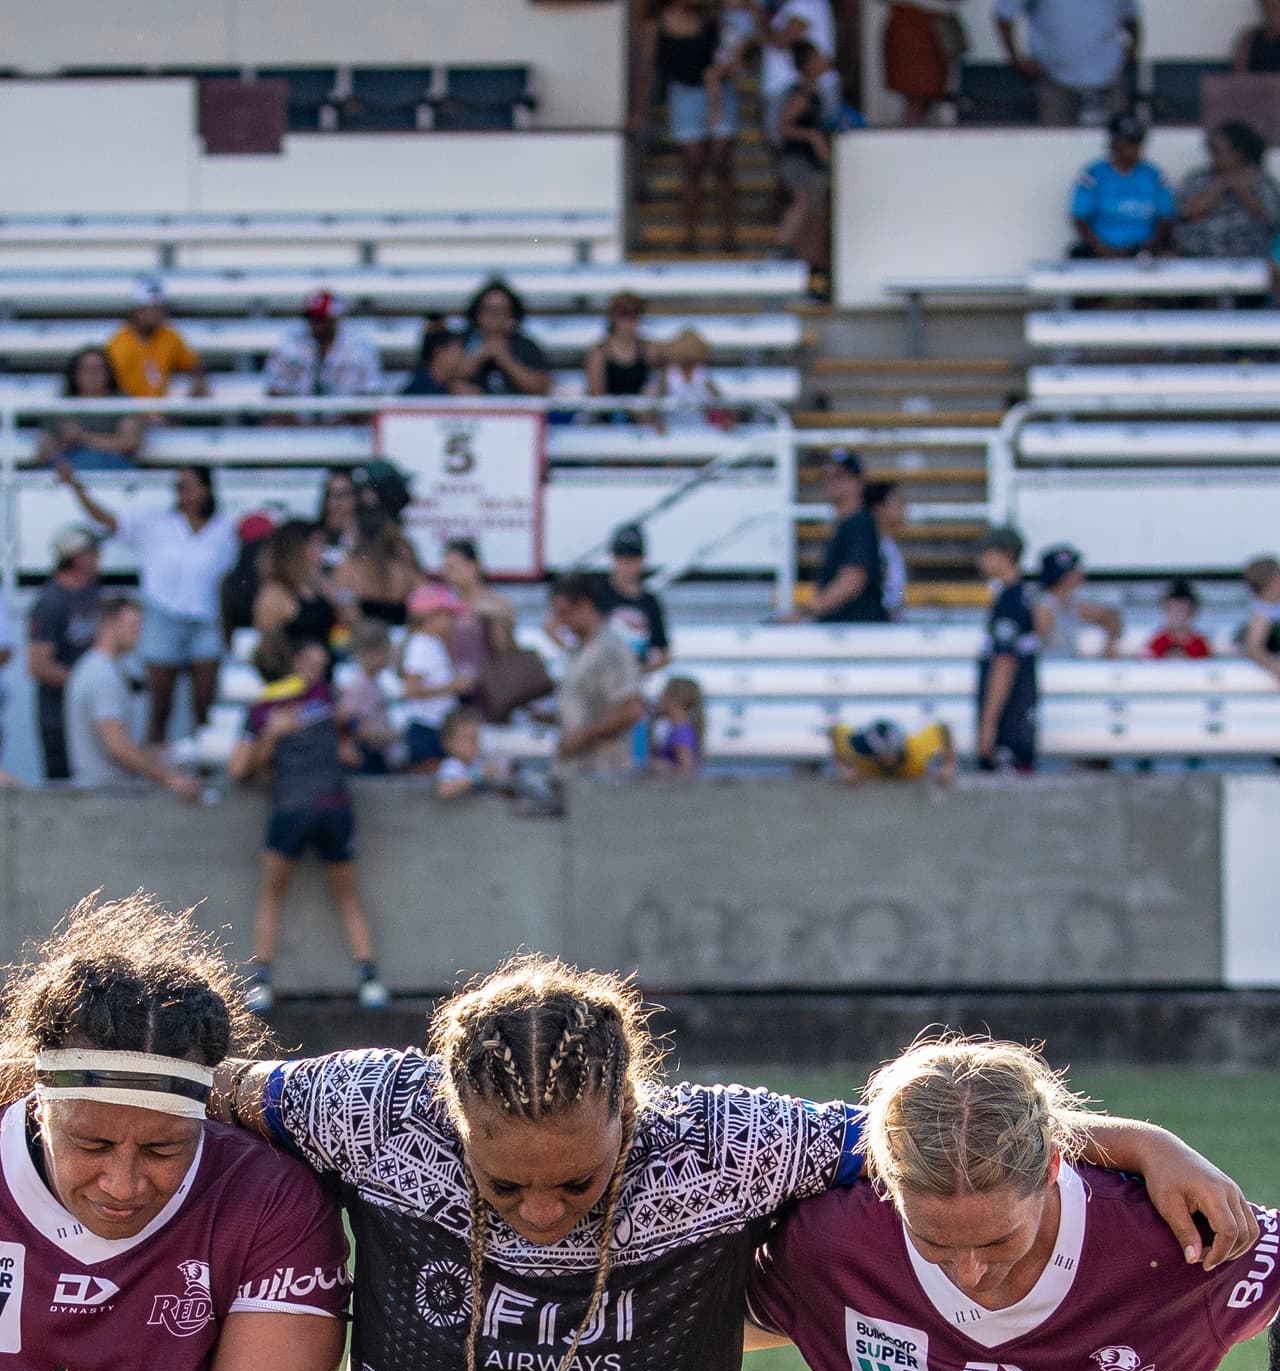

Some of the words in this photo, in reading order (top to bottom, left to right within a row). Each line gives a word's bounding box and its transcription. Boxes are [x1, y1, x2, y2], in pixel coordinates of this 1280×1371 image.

[444, 433, 477, 476] 5
[49, 1304, 115, 1314] DYNASTY
[147, 1294, 216, 1337] RED
[482, 1283, 636, 1346] FIJI
[856, 1321, 917, 1353] Buildcorp
[856, 1339, 919, 1370] SUPER
